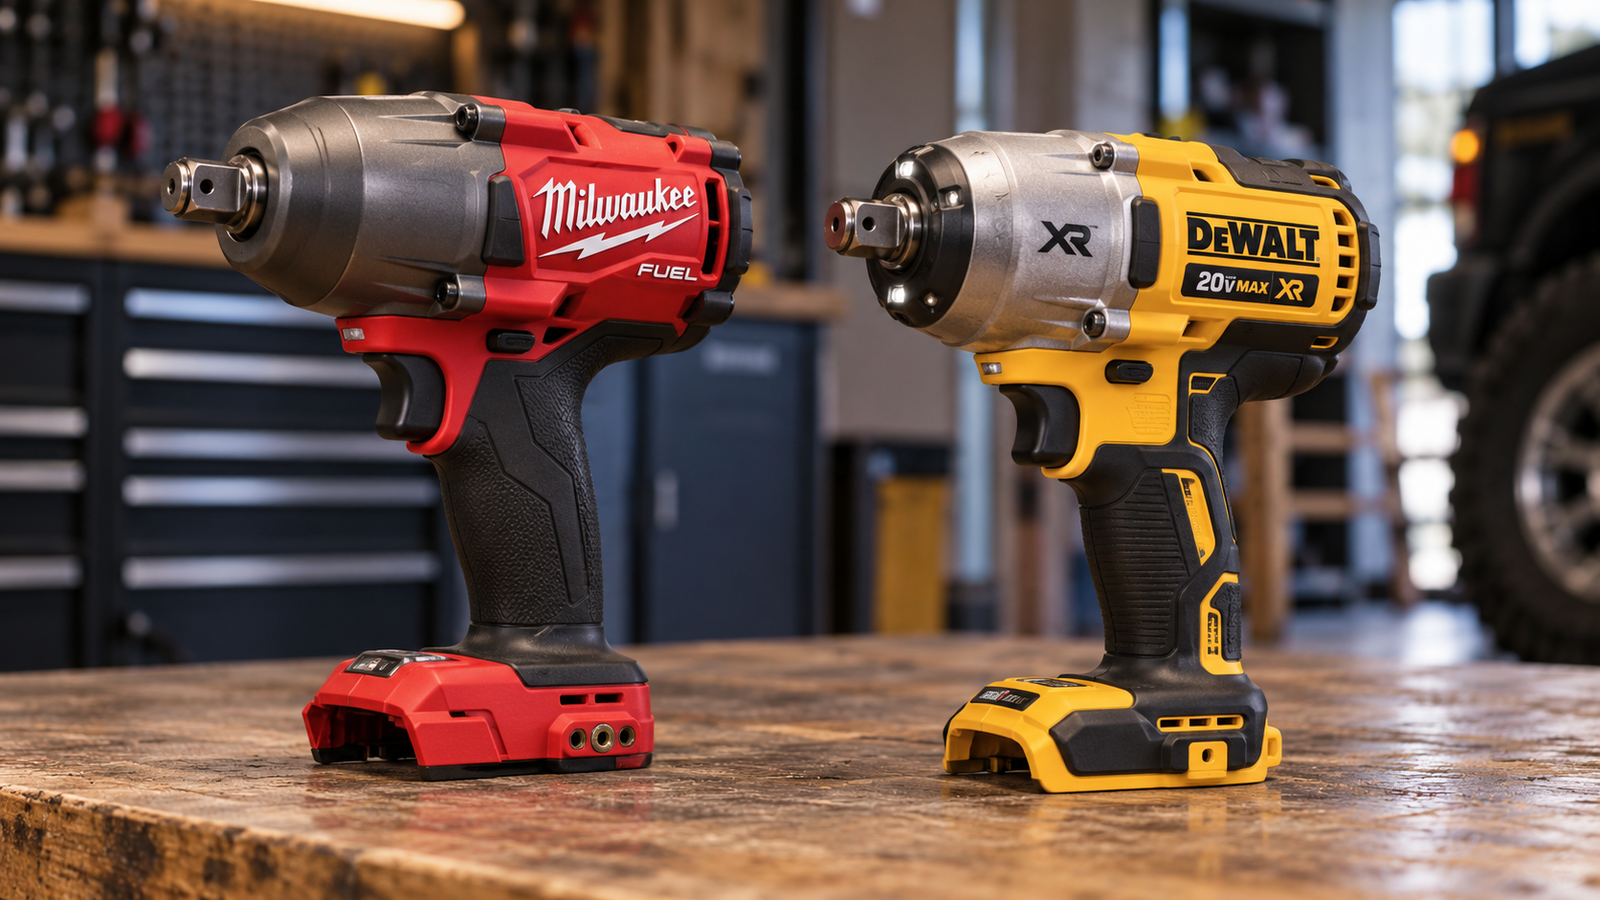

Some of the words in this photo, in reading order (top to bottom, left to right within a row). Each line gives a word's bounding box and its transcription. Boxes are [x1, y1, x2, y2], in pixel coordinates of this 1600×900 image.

[531, 177, 697, 240] Milwaukee
[1037, 220, 1093, 258] XR
[637, 263, 698, 282] FUEL
[1274, 277, 1304, 302] XR
